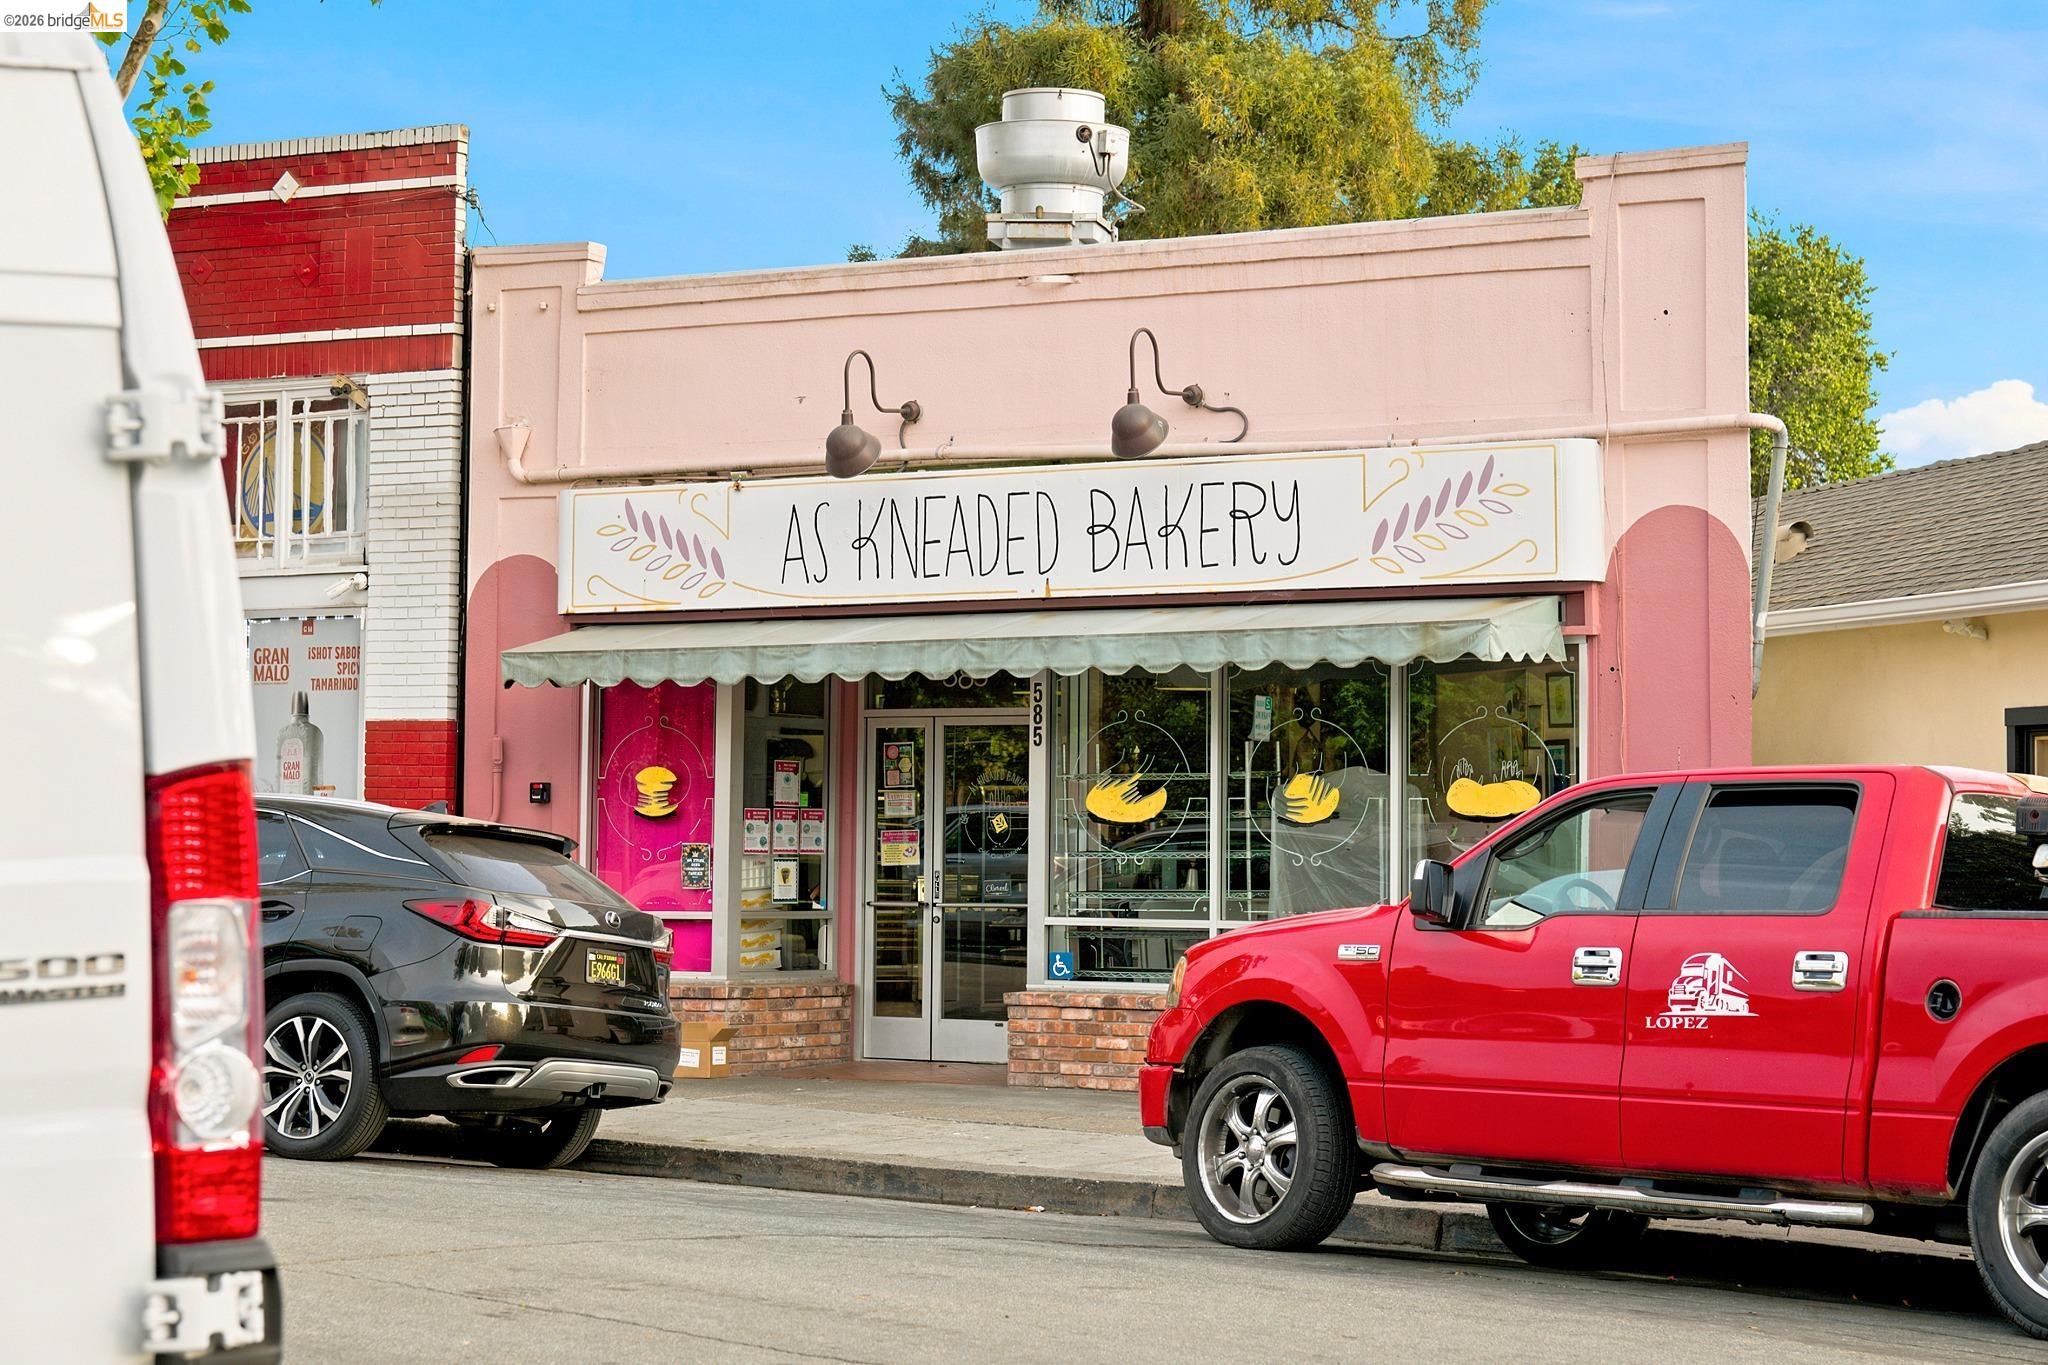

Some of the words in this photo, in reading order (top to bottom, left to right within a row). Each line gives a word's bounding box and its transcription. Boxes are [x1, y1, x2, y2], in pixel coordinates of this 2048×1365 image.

[782, 502, 829, 584] AS
[852, 491, 1059, 580] KNEADED
[1086, 480, 1300, 573] BAKERY
[253, 647, 289, 665] GRAN
[253, 664, 290, 682] MALO
[311, 677, 359, 691] TAMARINDO
[1032, 682, 1043, 747] 585
[283, 761, 300, 771] GRAN
[283, 770, 301, 780] MALO
[1645, 1016, 1709, 1029] LOPEZ
